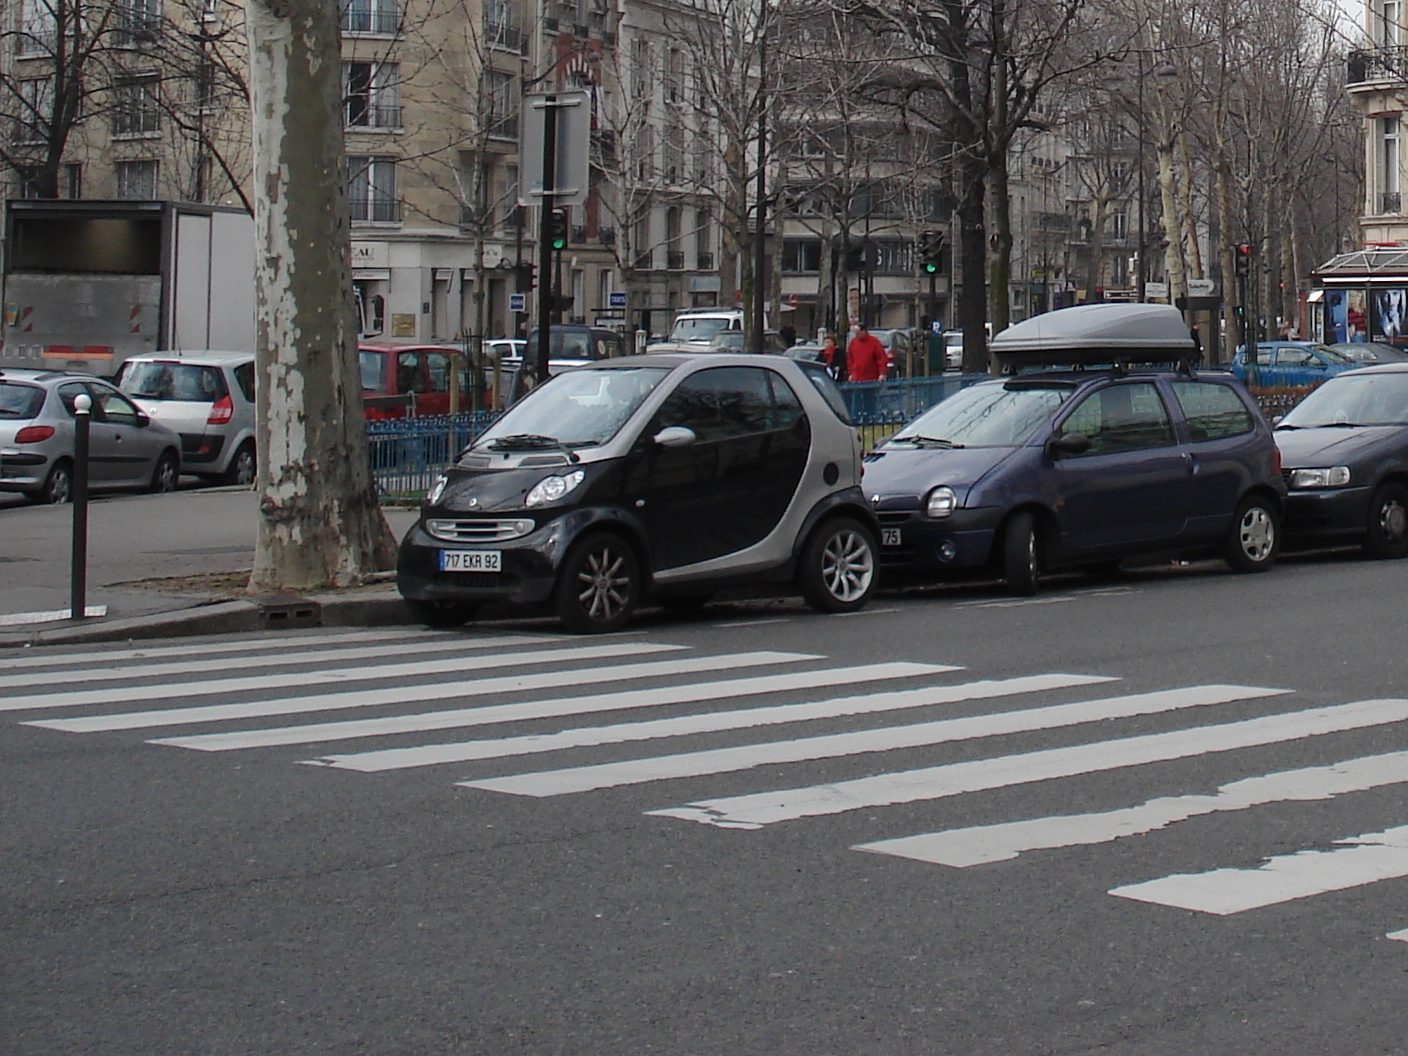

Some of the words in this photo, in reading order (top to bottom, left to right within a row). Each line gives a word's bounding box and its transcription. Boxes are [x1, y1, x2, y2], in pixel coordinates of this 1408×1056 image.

[883, 530, 898, 544] 75
[445, 554, 460, 568] 717
[485, 554, 498, 569] 92
